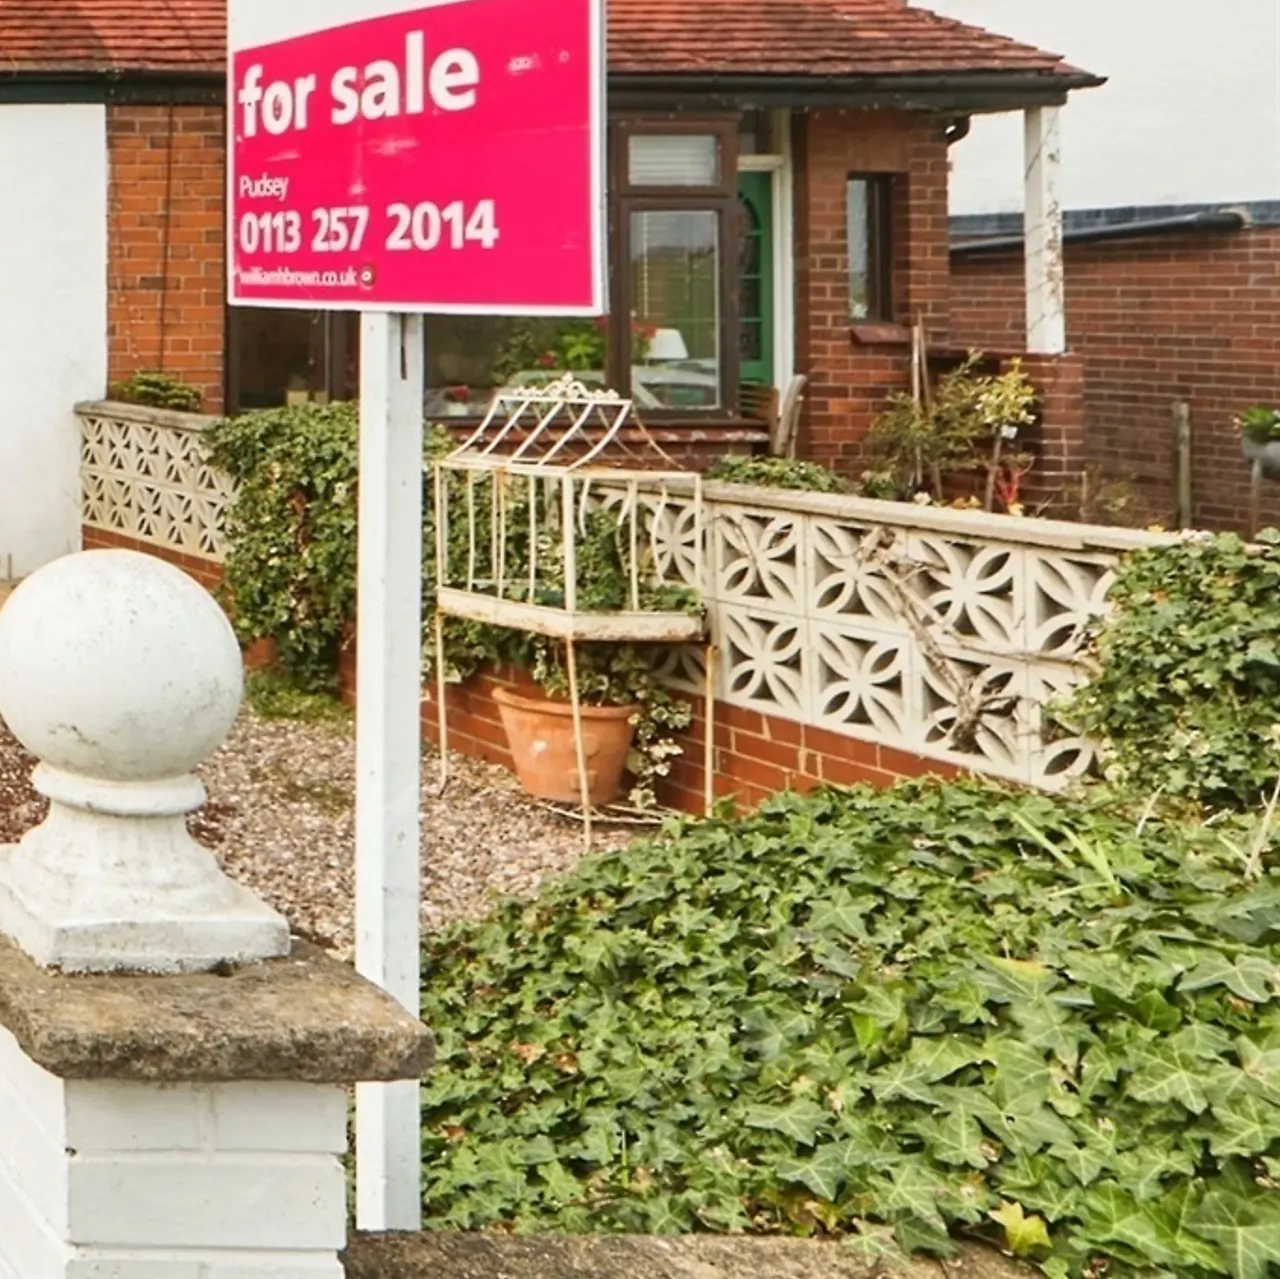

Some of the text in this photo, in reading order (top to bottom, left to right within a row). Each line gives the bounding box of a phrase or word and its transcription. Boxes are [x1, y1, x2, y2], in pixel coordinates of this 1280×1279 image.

[240, 30, 480, 139] for sale
[240, 172, 289, 200] Pudsey
[240, 199, 500, 253] 0113 257 2014
[240, 266, 357, 287] williamhbrown.co.uk
